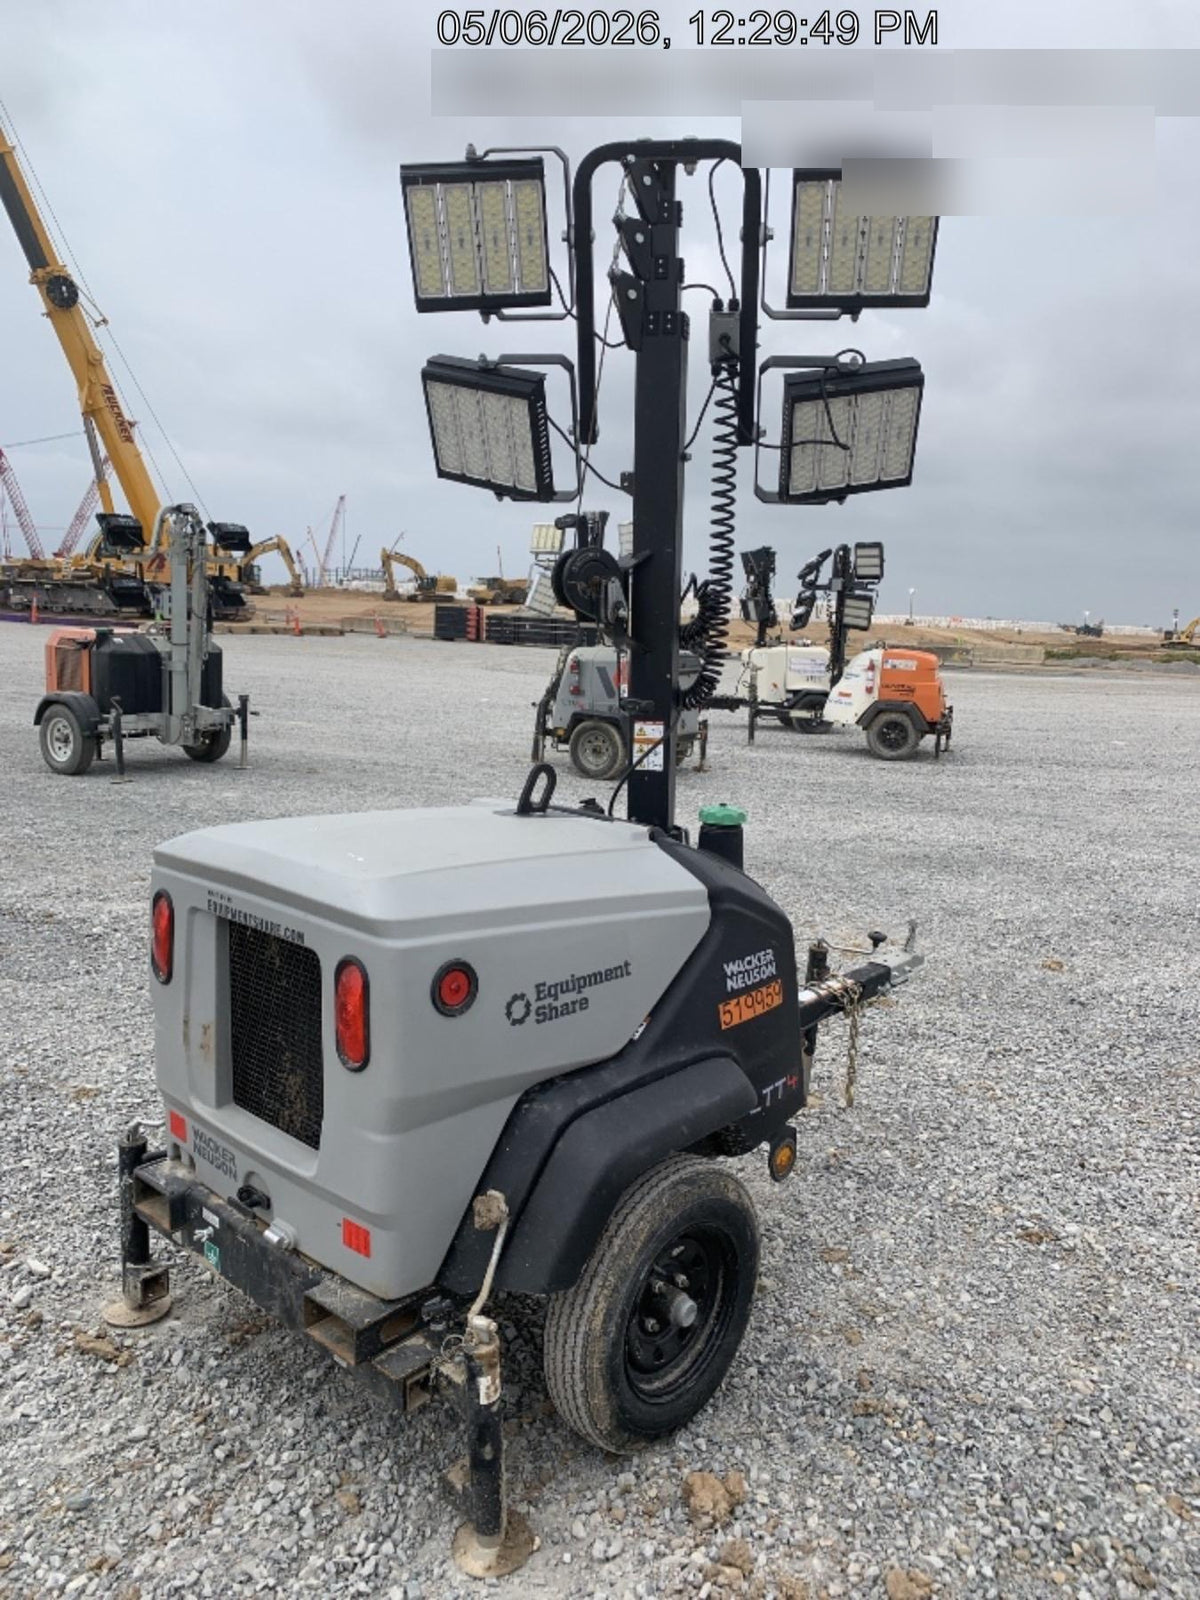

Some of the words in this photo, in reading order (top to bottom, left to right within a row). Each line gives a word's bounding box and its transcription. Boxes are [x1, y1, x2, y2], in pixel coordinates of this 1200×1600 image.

[534, 960, 632, 1002] Equipment
[723, 949, 775, 977] WACKER
[726, 962, 777, 993] NEUSON
[534, 997, 589, 1024] Share
[192, 1124, 236, 1169] WACKER
[193, 1140, 238, 1182] NEUSON
